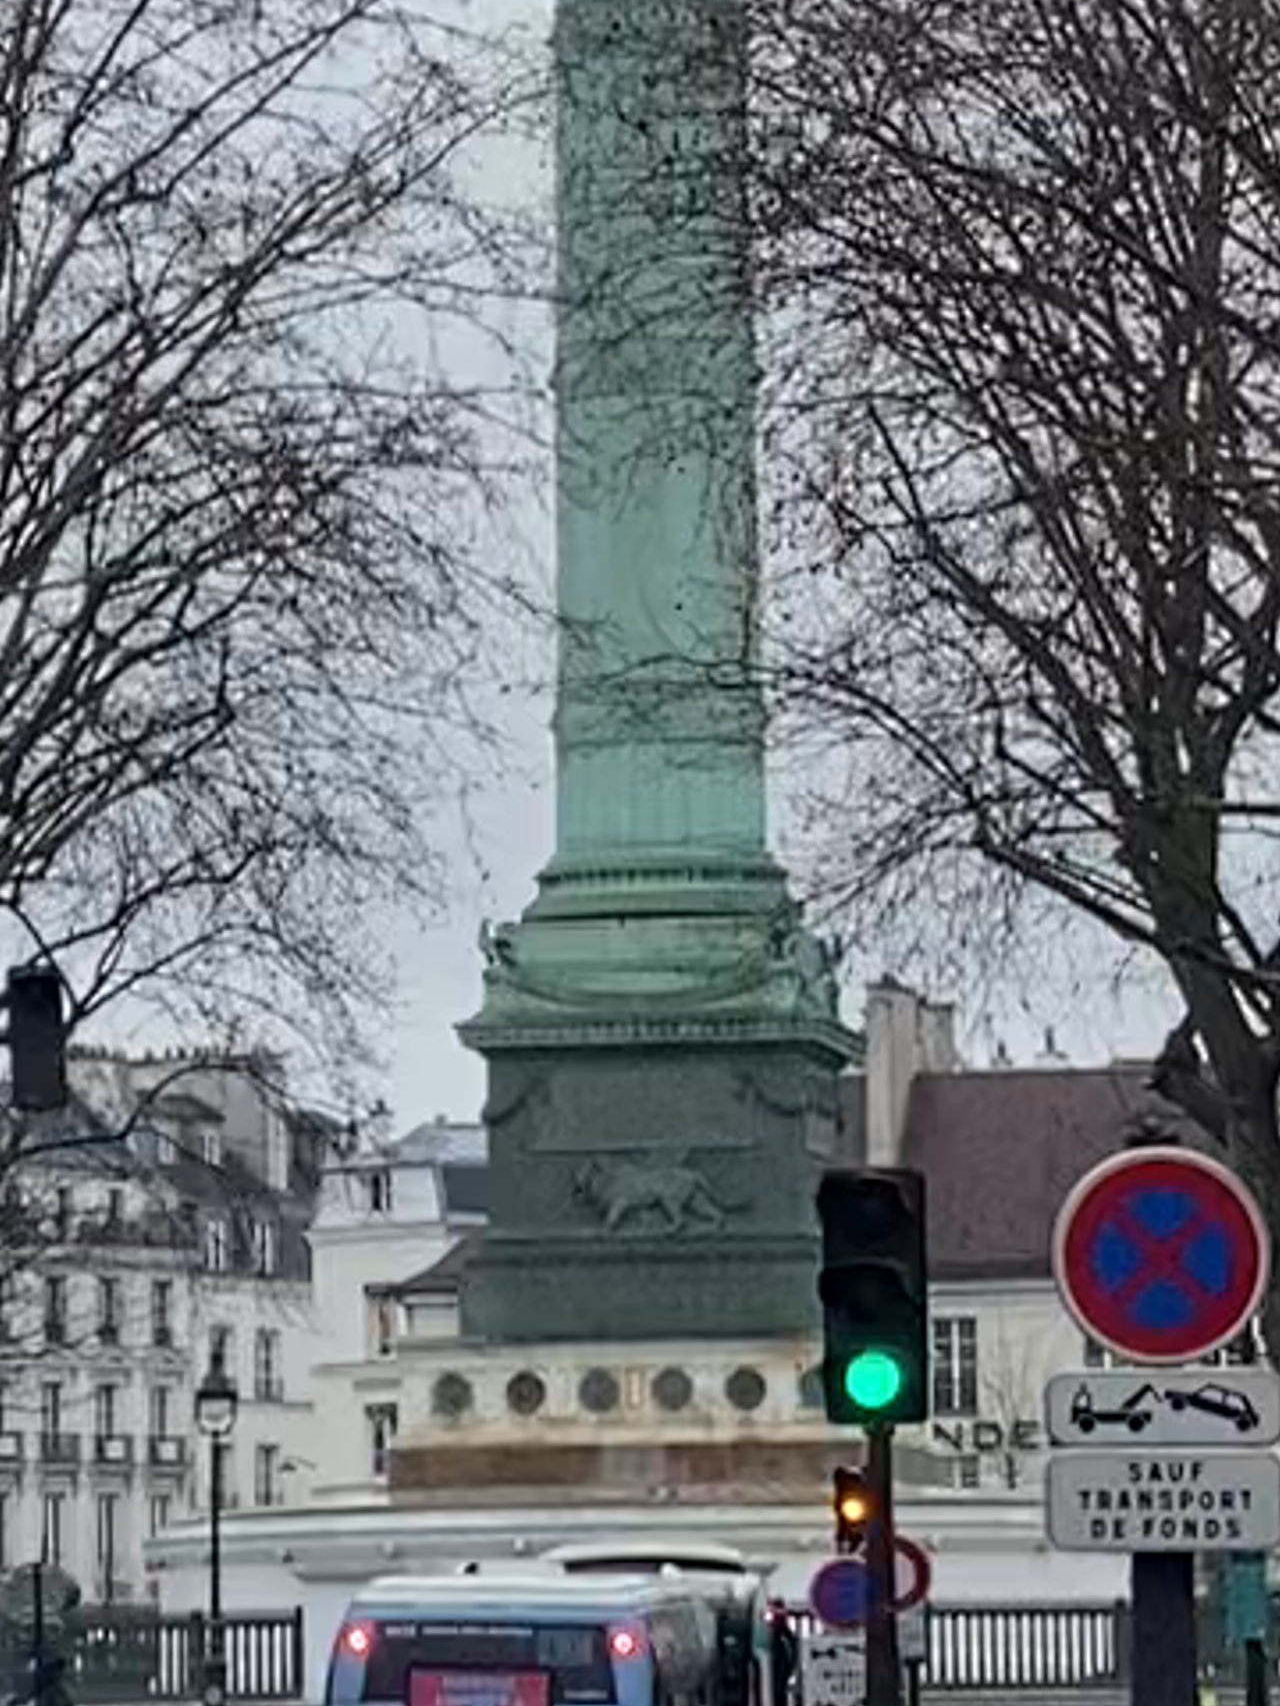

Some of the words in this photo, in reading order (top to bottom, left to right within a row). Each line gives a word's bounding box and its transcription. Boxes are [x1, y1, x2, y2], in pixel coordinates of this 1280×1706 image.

[1128, 1462, 1203, 1483] SAUF
[1078, 1489, 1252, 1511] TRANSPORT
[1090, 1518, 1126, 1539] DE
[1142, 1518, 1242, 1539] FONDS
